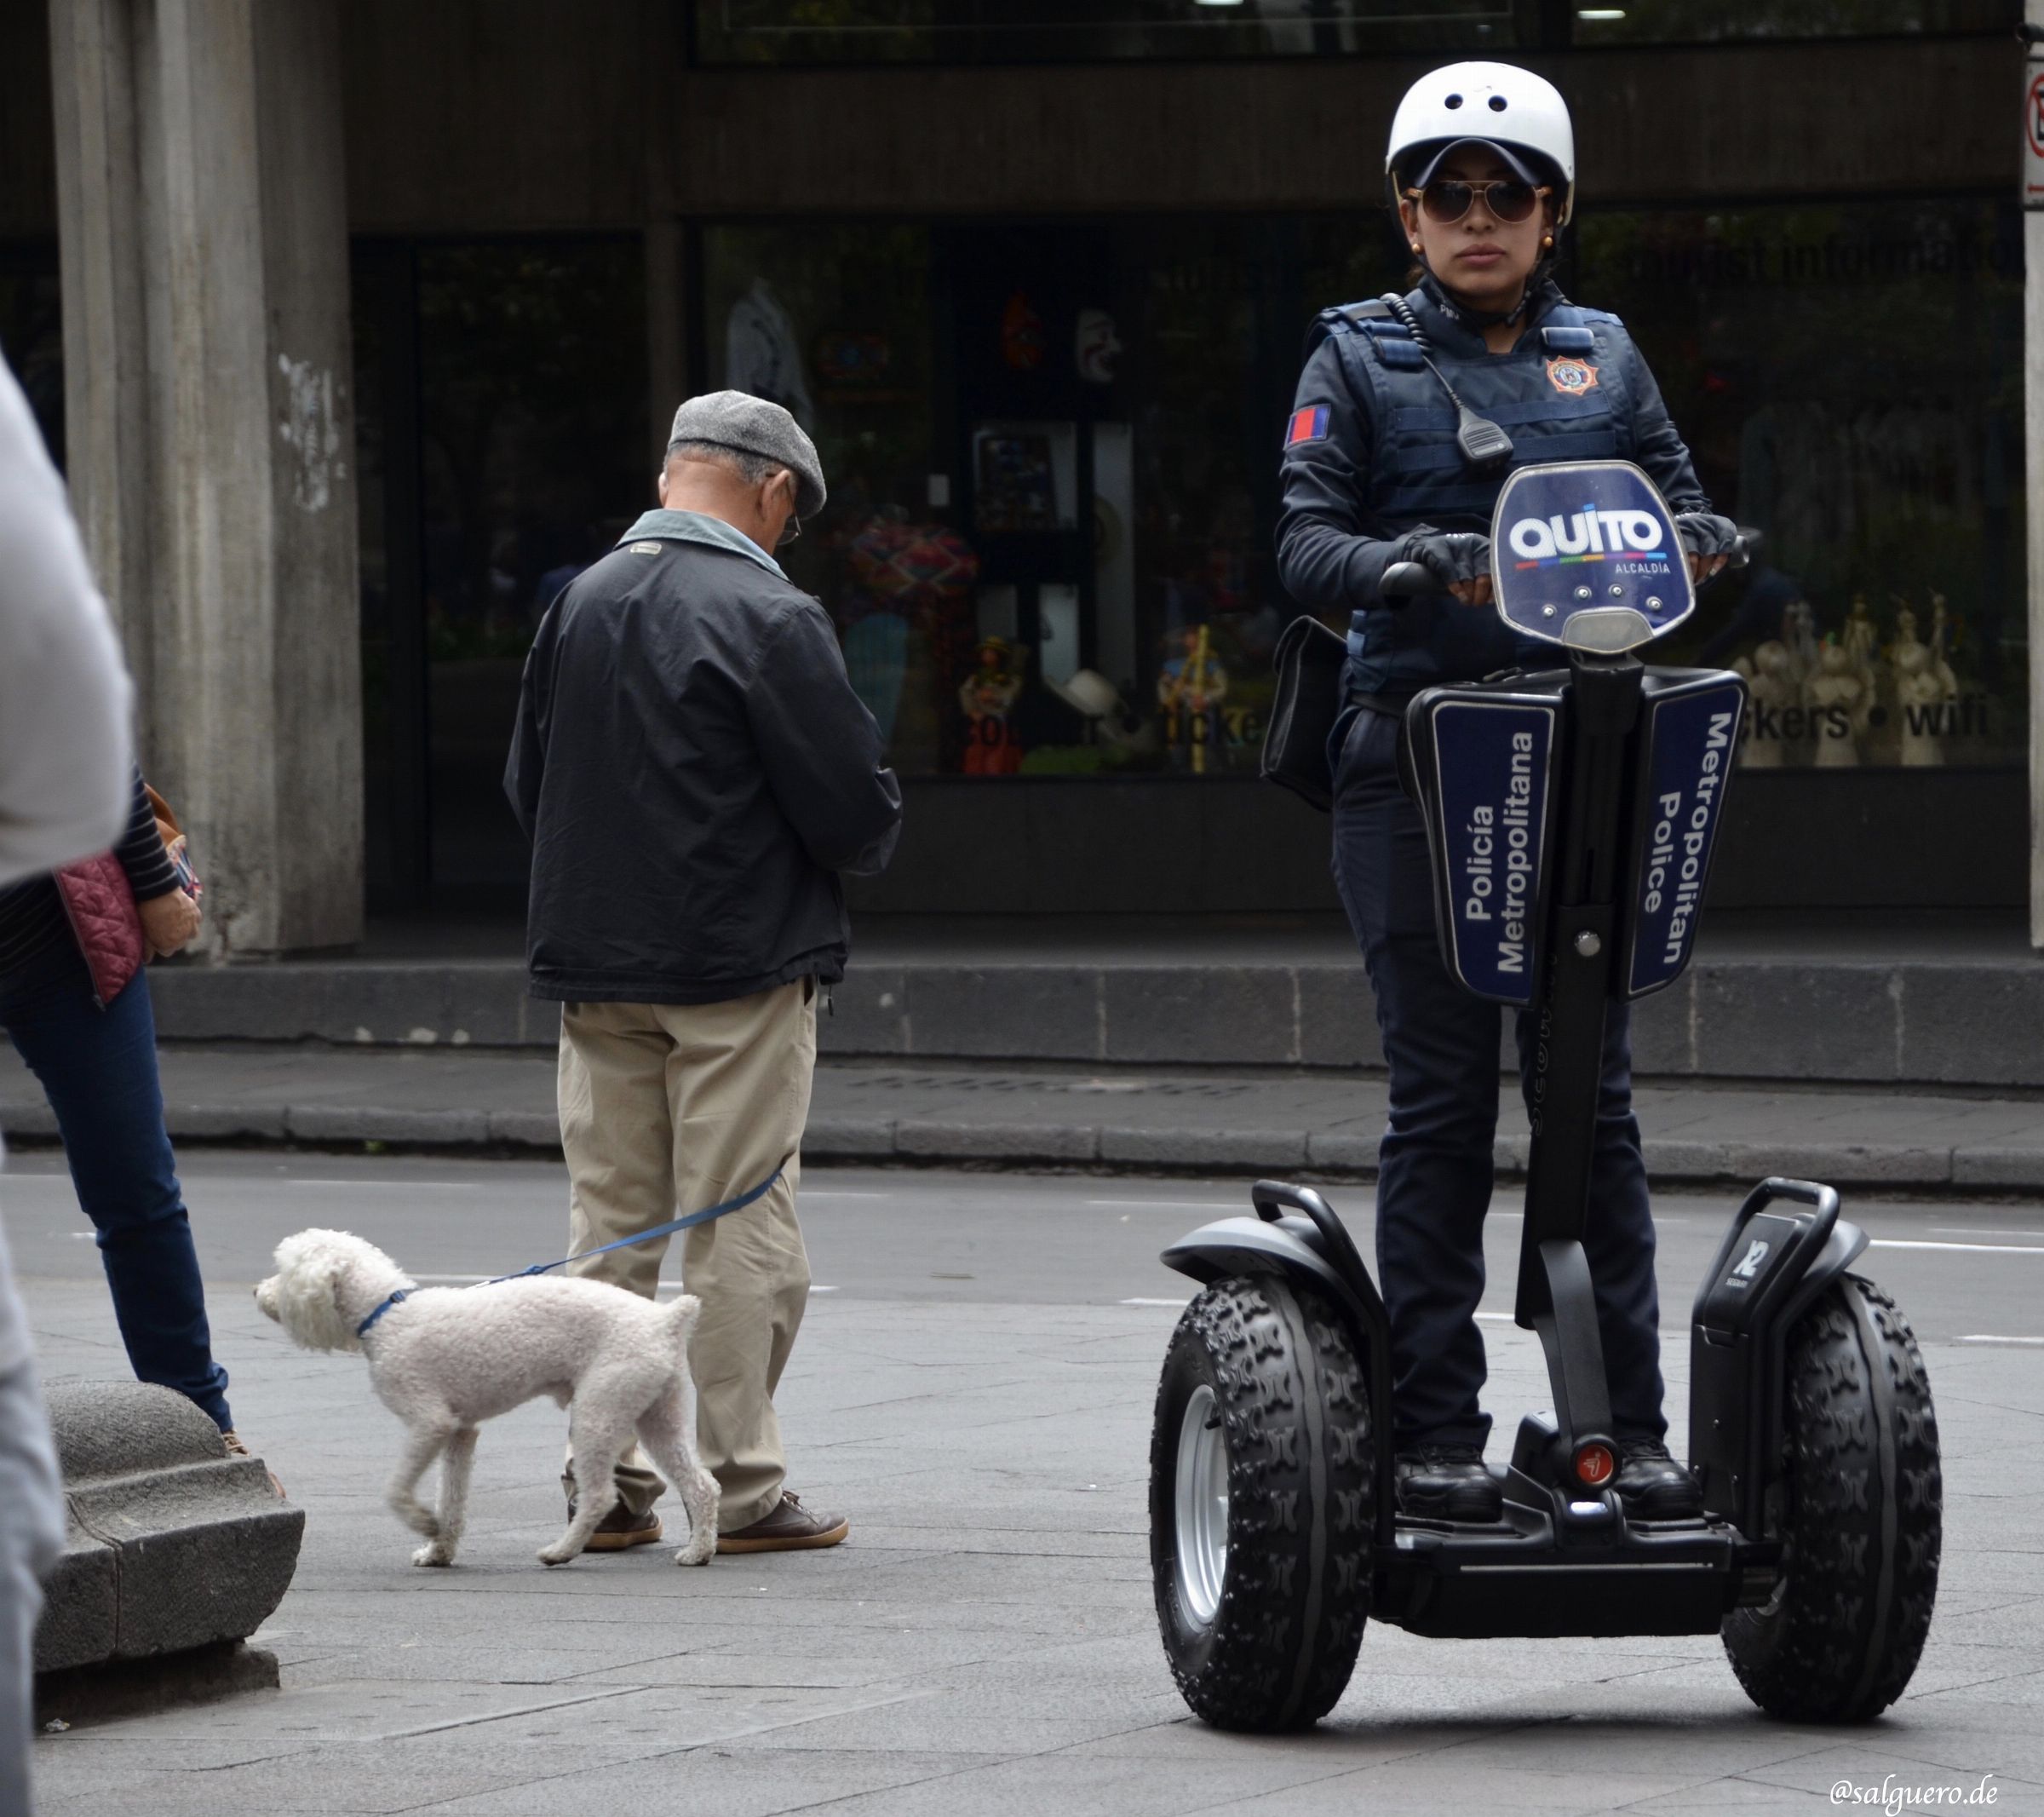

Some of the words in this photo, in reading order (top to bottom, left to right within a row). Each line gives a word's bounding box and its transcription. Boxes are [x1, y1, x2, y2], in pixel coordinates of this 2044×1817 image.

[1616, 561, 1670, 573] ALCALDÍA
[1160, 700, 1260, 745] ticke
[1906, 693, 1986, 737] wifi
[1466, 805, 1494, 921] Policía
[1497, 731, 1533, 973] Metropolitana
[1644, 791, 1682, 914] Police
[1662, 712, 1732, 964] Metropolitan
